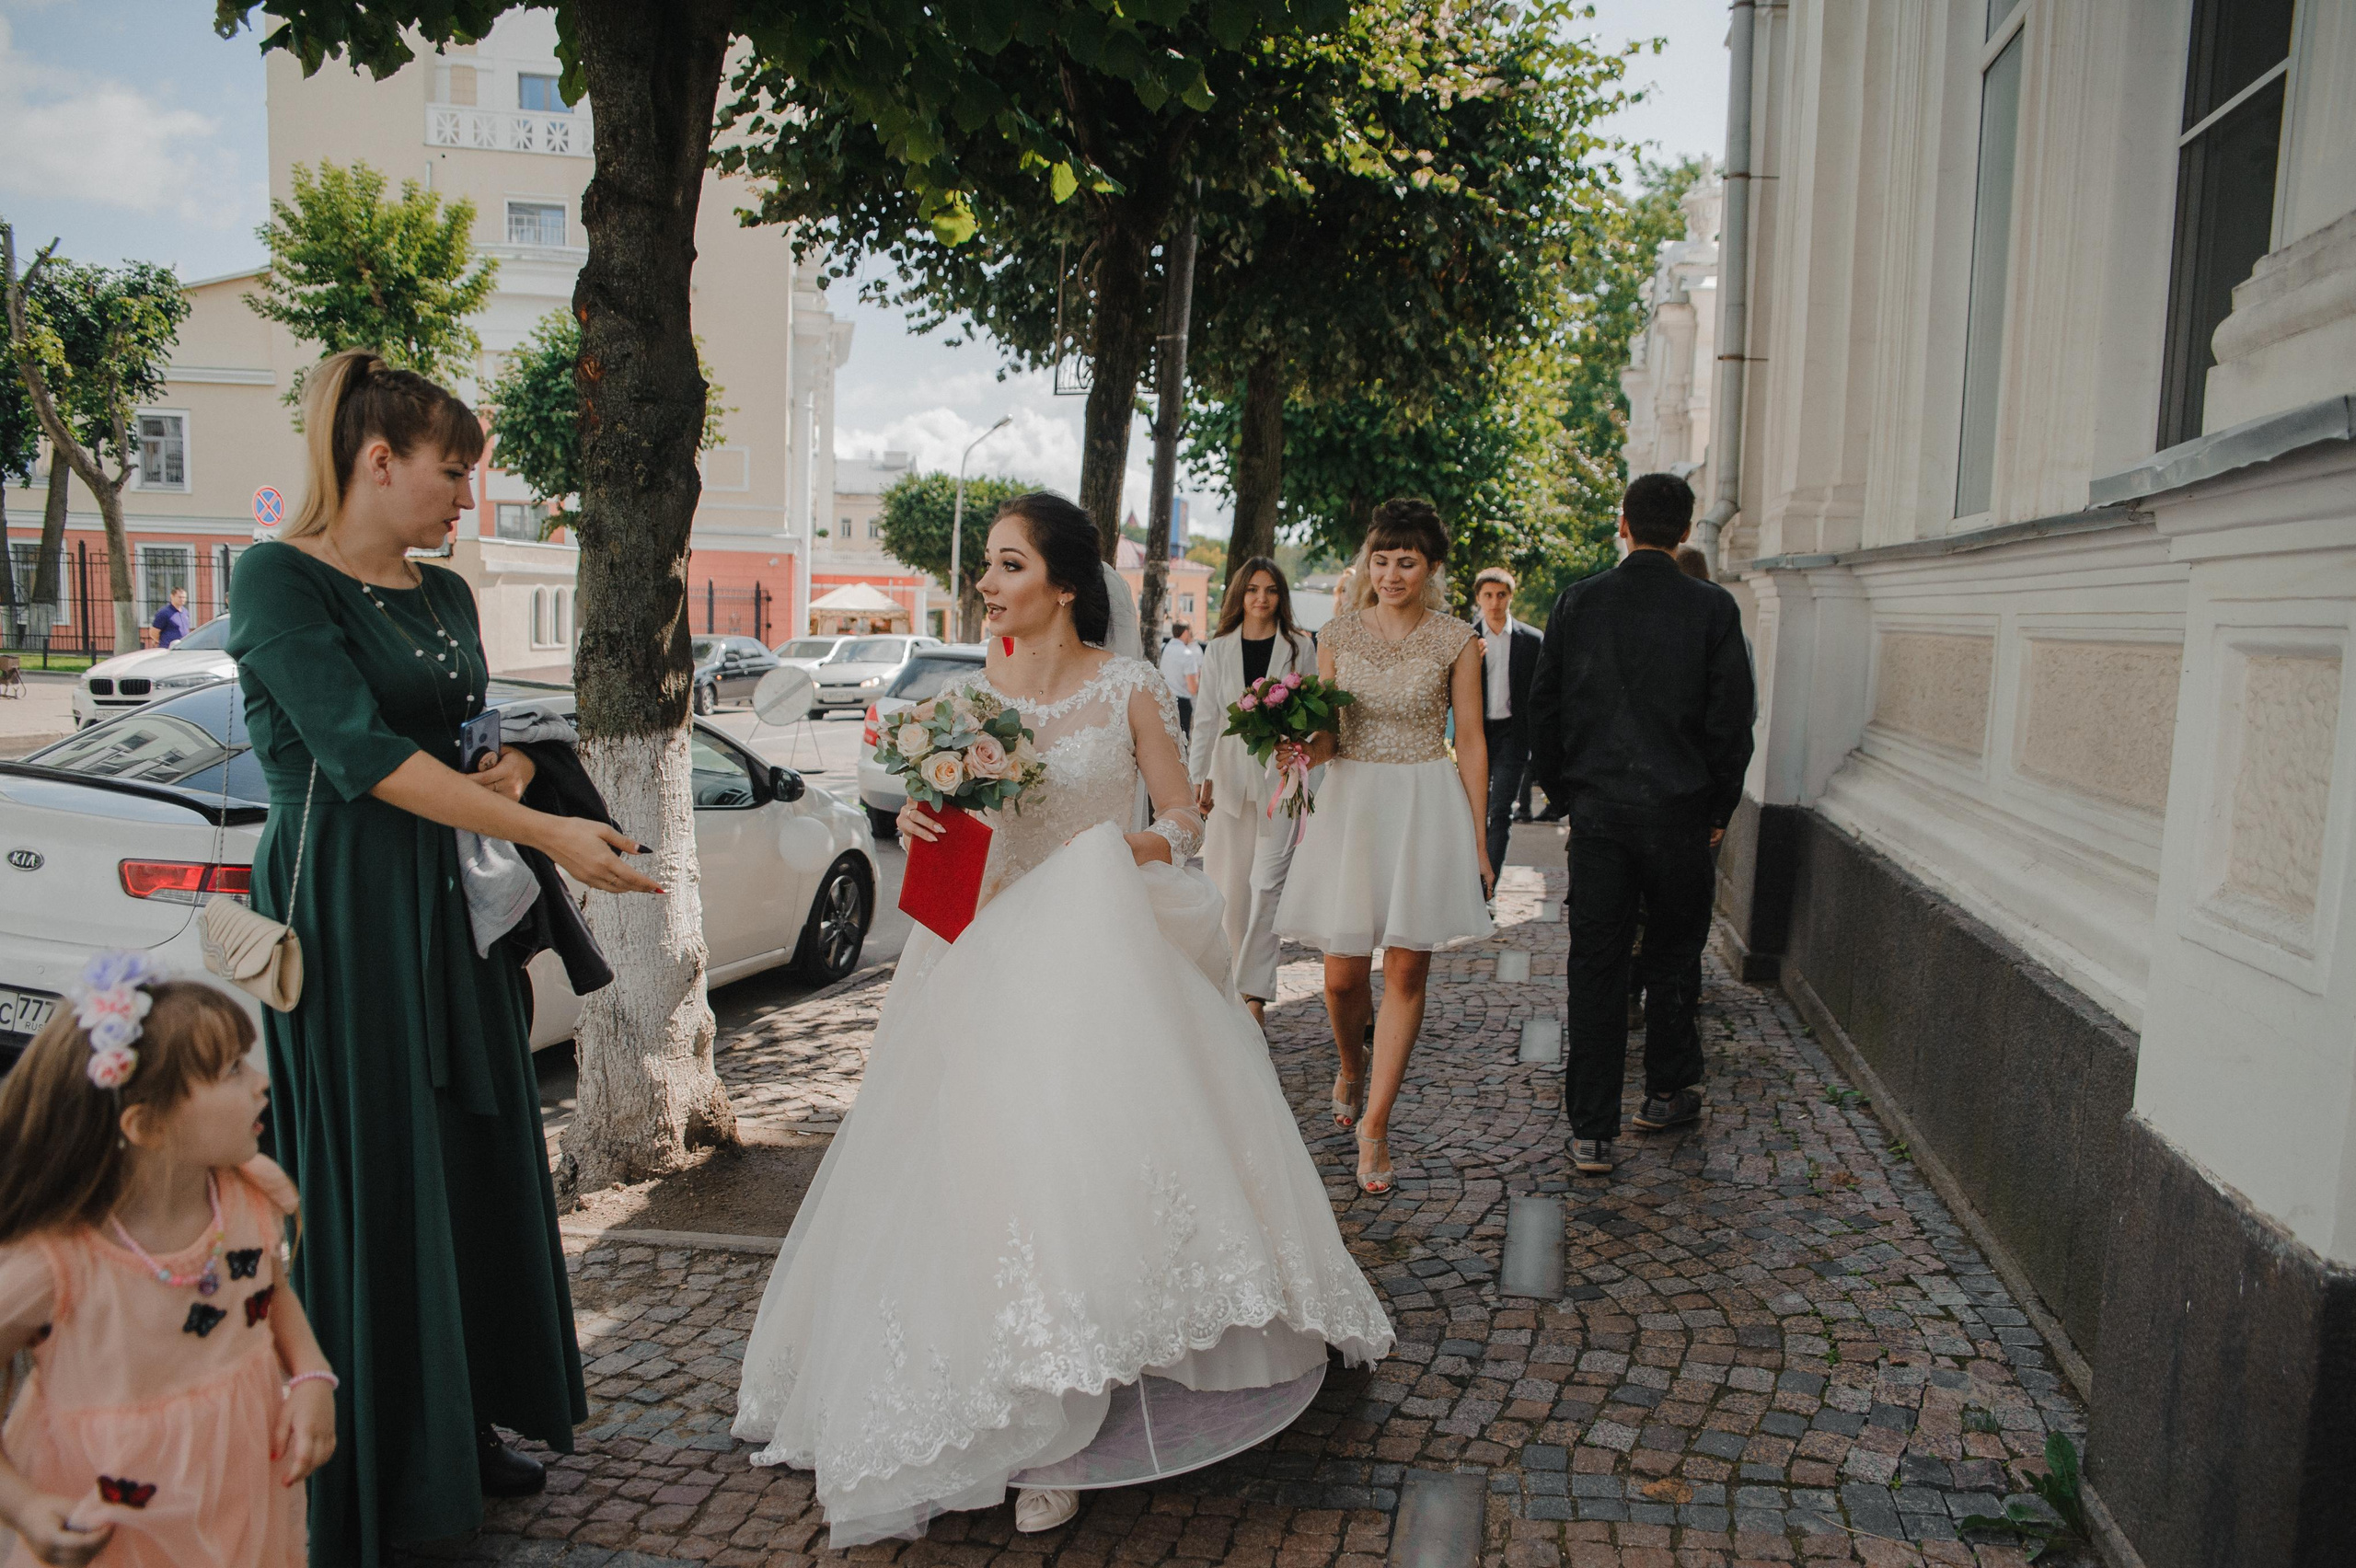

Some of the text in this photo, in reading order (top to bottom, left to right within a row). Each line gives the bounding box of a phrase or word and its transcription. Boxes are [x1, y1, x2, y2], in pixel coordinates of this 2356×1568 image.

[12, 851, 36, 867] KIA
[18, 997, 56, 1024] 777
[25, 1021, 44, 1032] RUS
